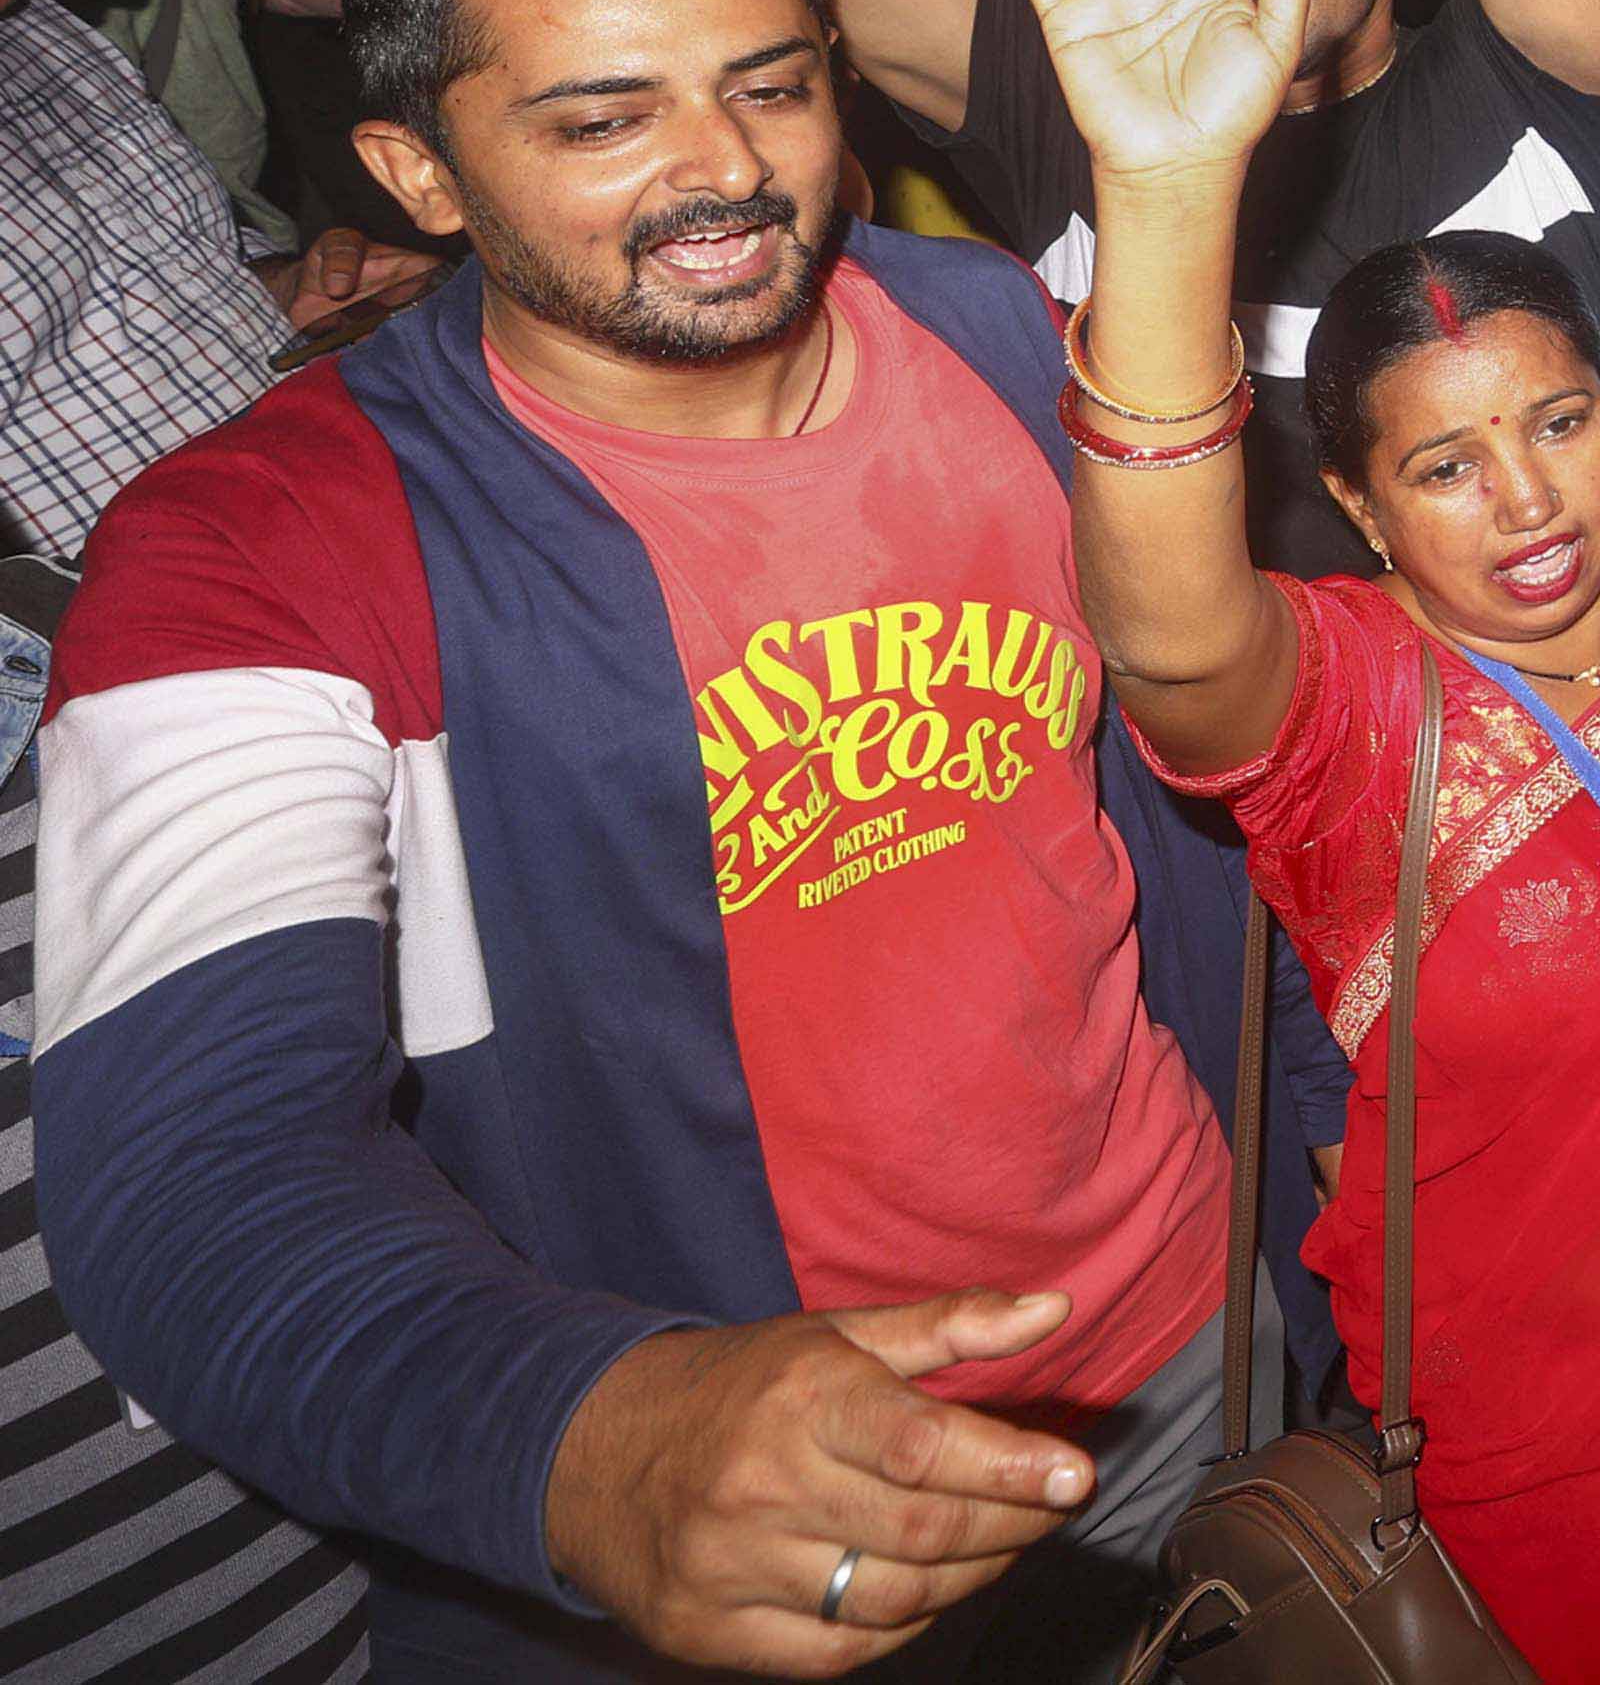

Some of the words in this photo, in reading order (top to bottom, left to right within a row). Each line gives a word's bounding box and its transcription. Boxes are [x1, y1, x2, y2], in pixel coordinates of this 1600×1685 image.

[744, 600, 1086, 751] STRAUSS
[748, 765, 832, 869] And
[797, 855, 872, 910] RIVETED
[873, 820, 967, 876] CLOTHING
[832, 807, 909, 864] PATENT
